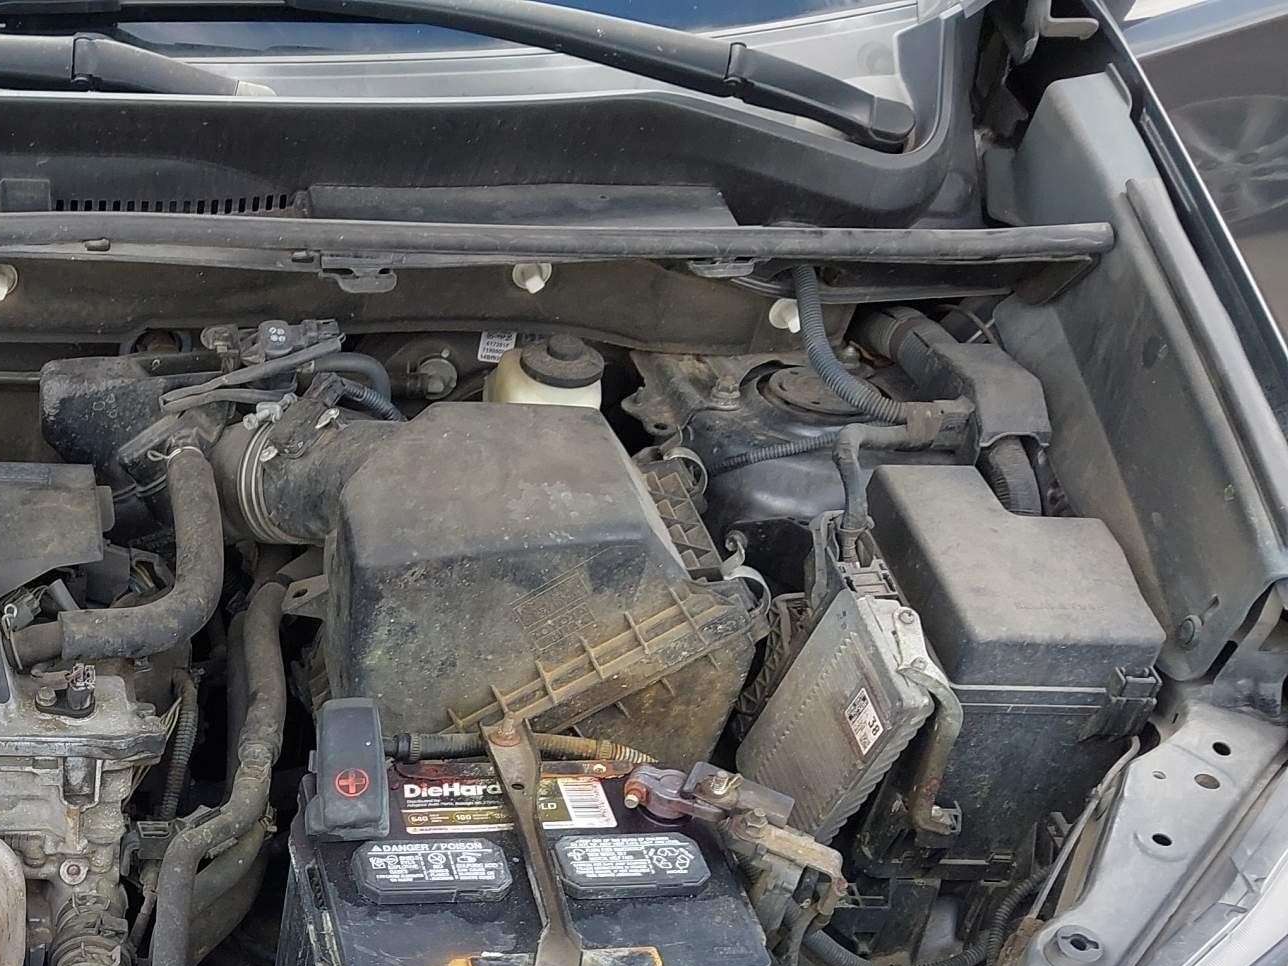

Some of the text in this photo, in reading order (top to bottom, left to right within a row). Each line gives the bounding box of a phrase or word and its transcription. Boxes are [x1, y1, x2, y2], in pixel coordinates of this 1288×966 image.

[403, 783, 503, 798] DieHard
[382, 844, 429, 852] DANGER
[440, 842, 483, 850] POISON
